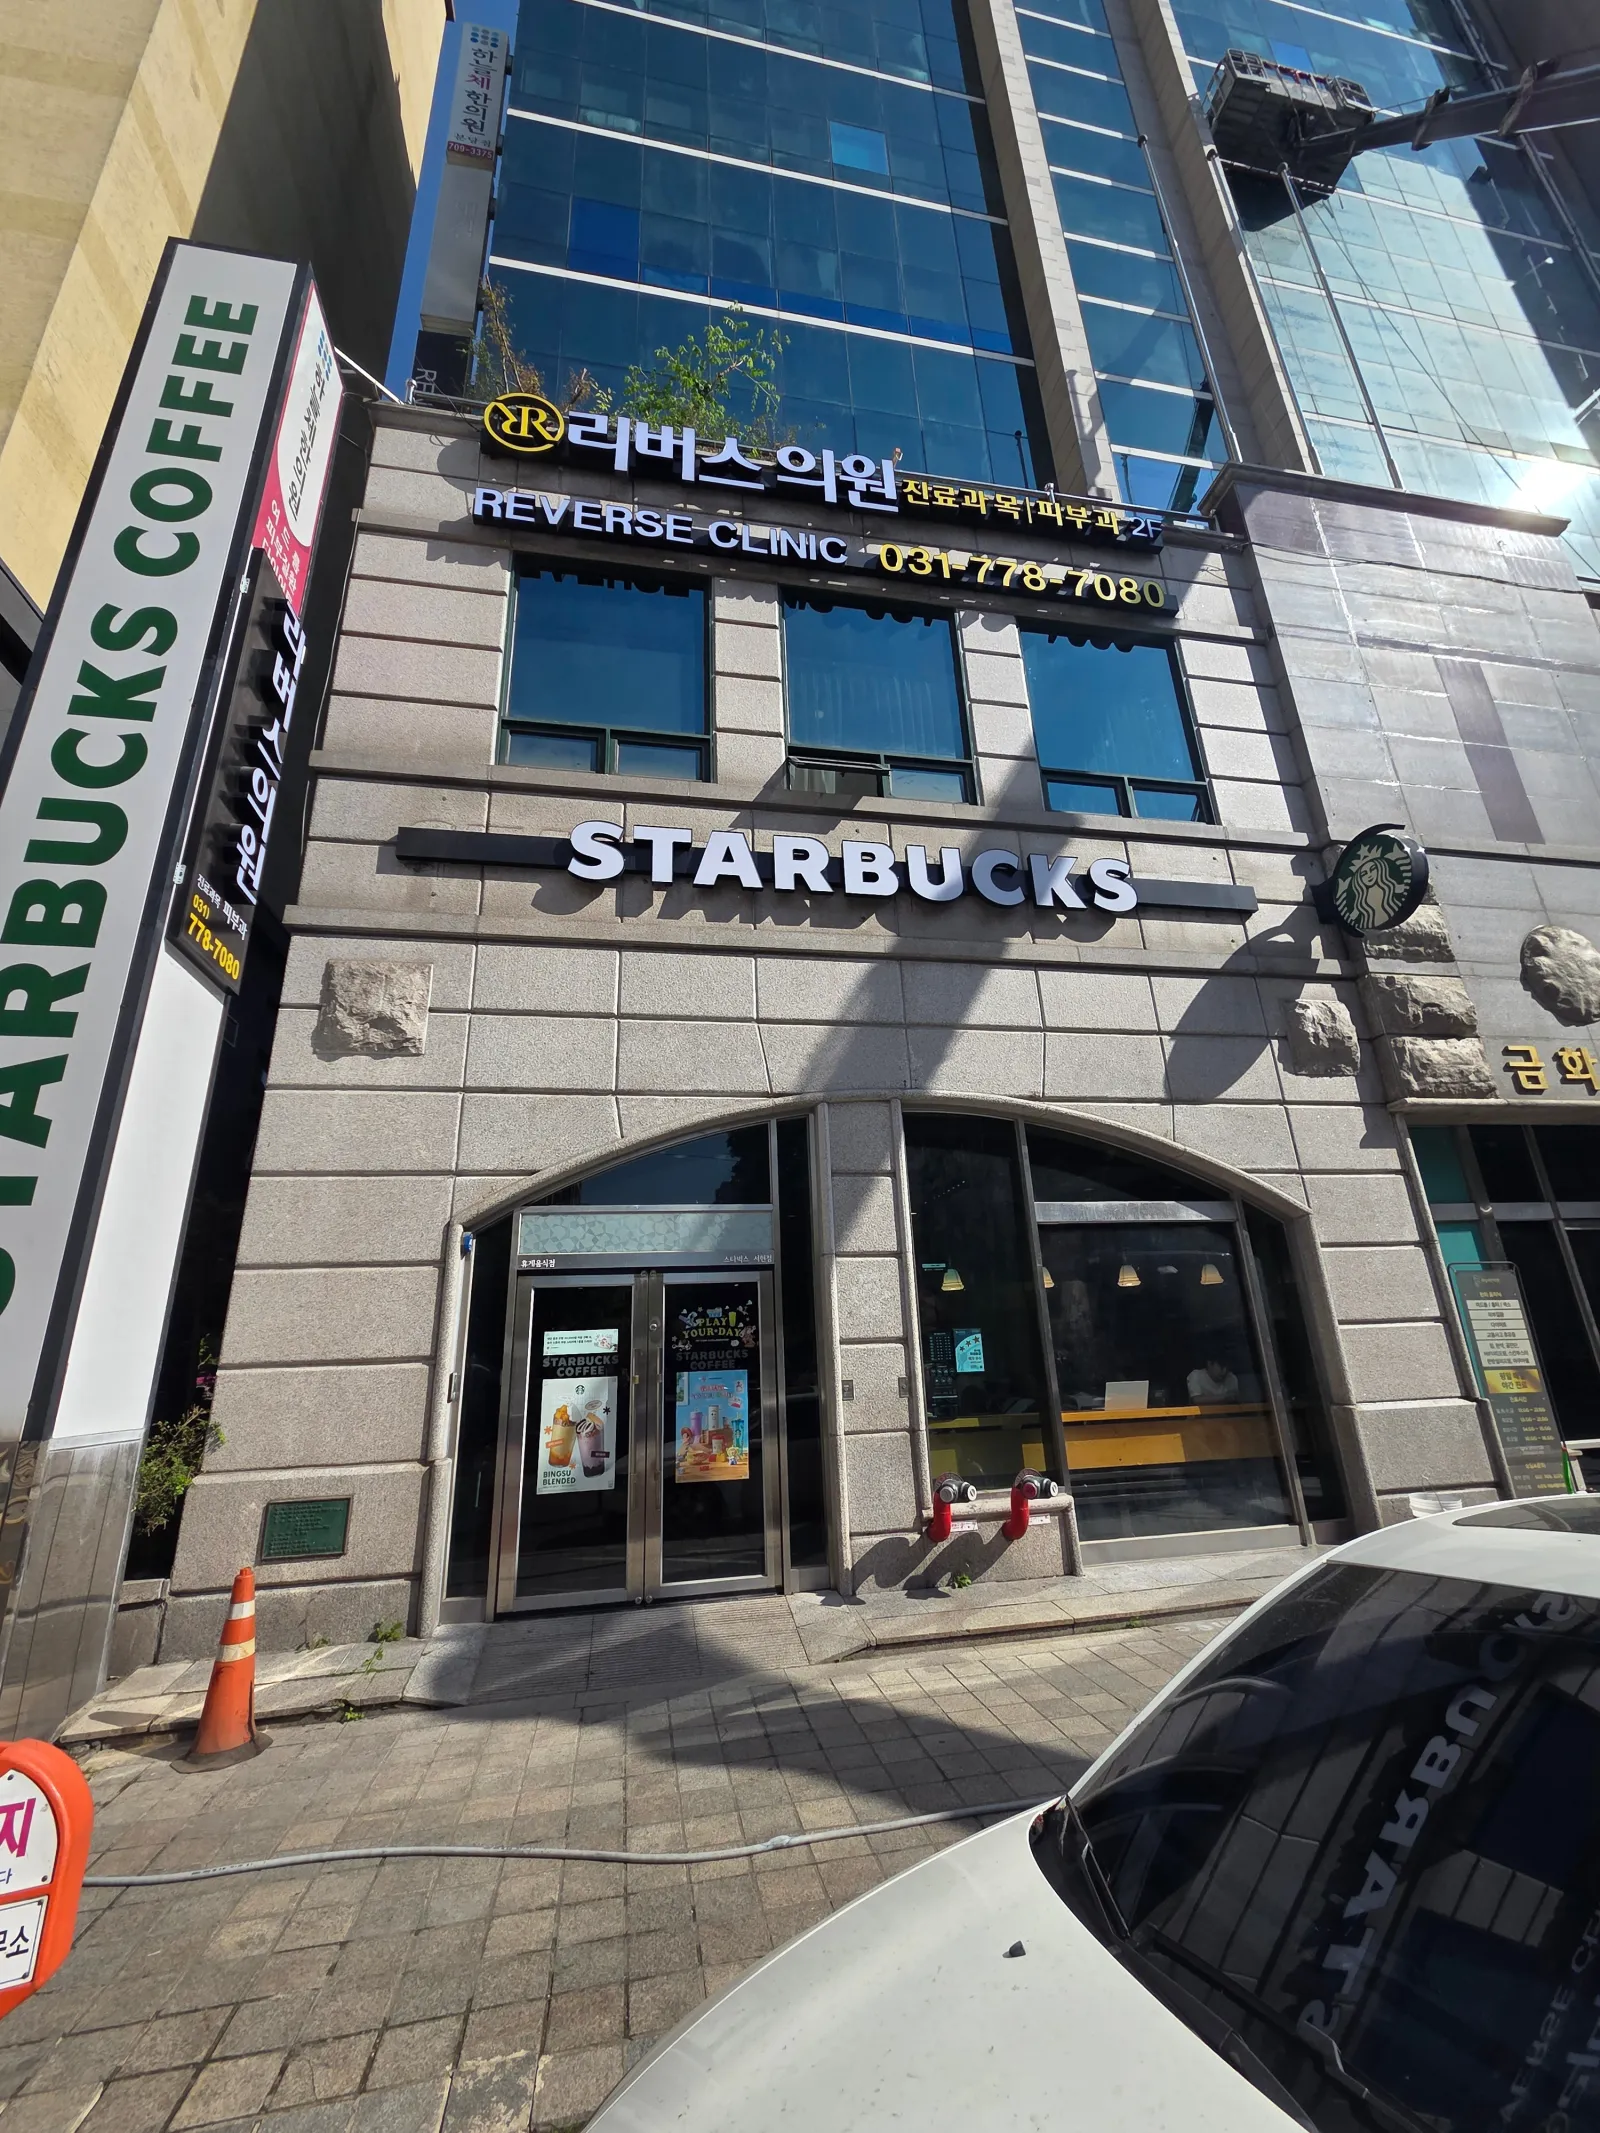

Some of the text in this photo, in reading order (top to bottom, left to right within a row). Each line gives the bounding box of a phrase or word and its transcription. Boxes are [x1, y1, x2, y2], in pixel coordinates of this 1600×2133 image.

[448, 142, 493, 160] 709-3375
[114, 294, 259, 577] COFFEE
[568, 410, 899, 513] 리버스의원
[902, 478, 1163, 539] 진료과목 피부과 2F
[473, 486, 849, 564] REVERSE CLINIC
[879, 542, 1166, 608] 031-778-7080
[236, 601, 306, 905] 리버스의원
[567, 819, 1139, 912] STARBUCKS
[192, 894, 210, 919] 031)
[197, 873, 248, 941] 진료과목 피부과
[188, 912, 240, 980] 778-7080
[0, 602, 178, 1316] ARBUCKS
[723, 1254, 773, 1264] 스타벅스 서현점
[683, 1327, 741, 1339] YOUR DAY
[697, 1317, 728, 1327] PLAY
[542, 1354, 620, 1368] STARBUCKS
[676, 1349, 749, 1361] STARBUCKS
[690, 1359, 736, 1371] COFFEE
[556, 1365, 605, 1378] COFFEE
[542, 1477, 576, 1486] BLENDED
[543, 1470, 572, 1479] BINGSU
